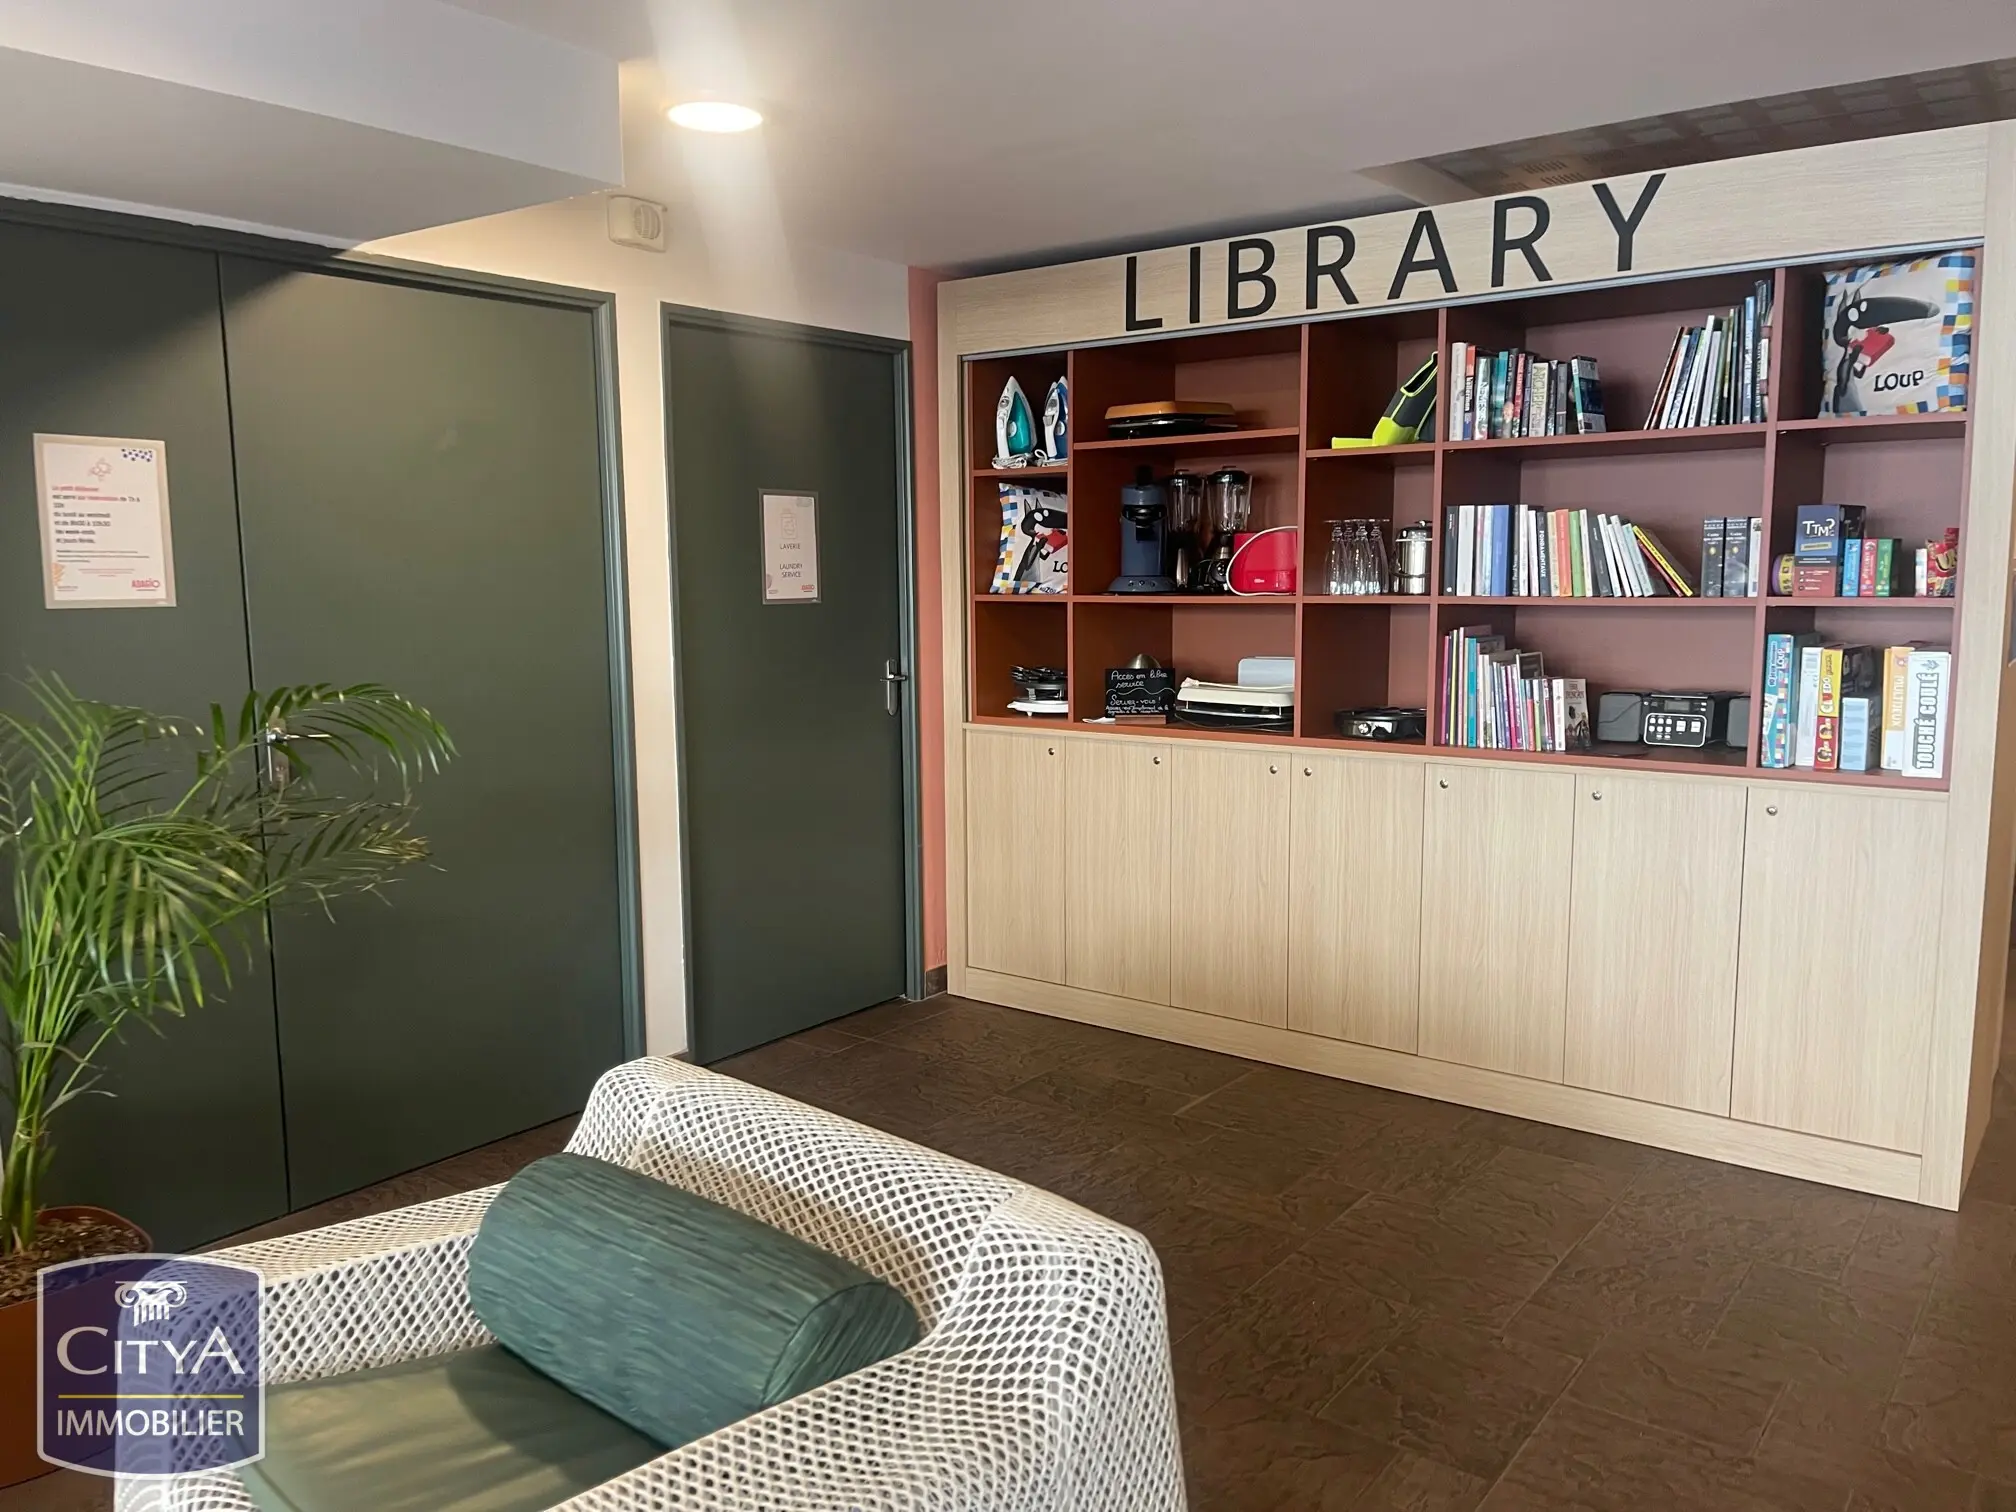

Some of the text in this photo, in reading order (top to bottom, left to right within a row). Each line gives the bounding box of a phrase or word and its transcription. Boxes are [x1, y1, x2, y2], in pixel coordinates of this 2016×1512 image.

[1125, 173, 1667, 331] LIBRARY
[1873, 370, 1924, 392] LOUP
[1053, 560, 1068, 573] LO
[1820, 676, 1834, 713] CLUEDO
[1913, 672, 1939, 769] TOUCHÉ COULÉ
